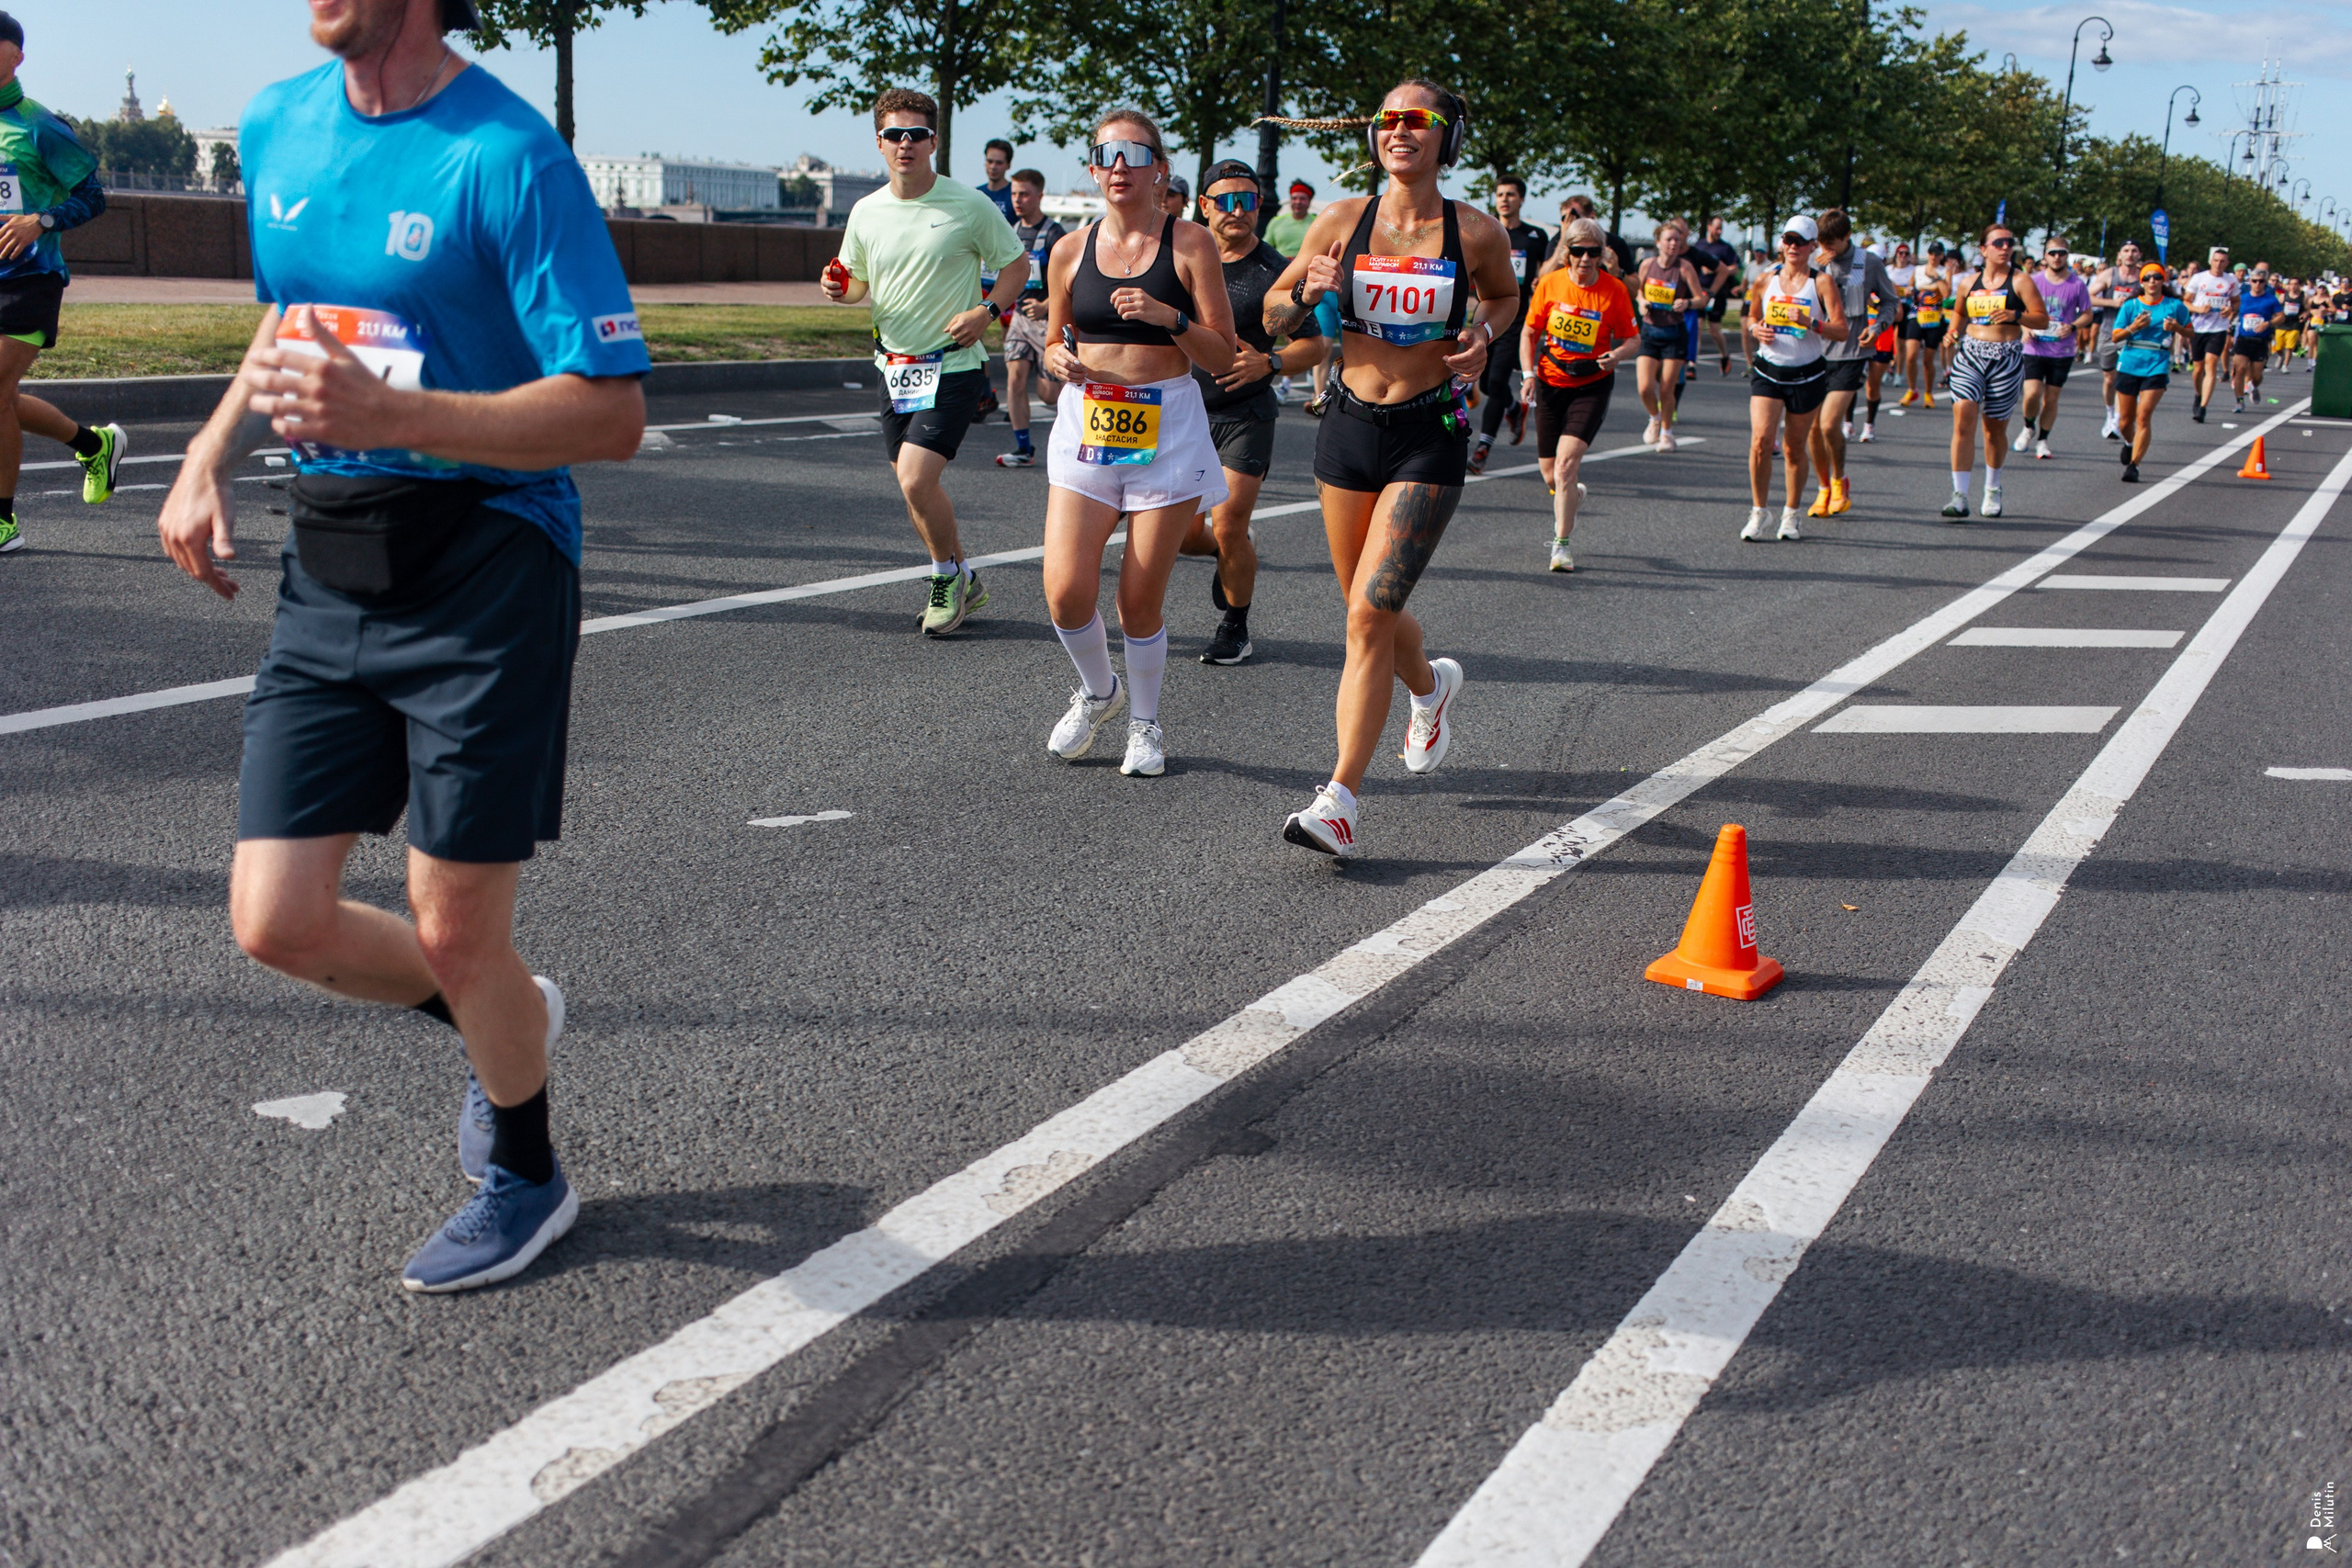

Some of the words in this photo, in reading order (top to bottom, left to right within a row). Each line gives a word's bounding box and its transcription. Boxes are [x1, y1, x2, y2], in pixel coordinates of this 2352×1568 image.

[384, 209, 435, 262] 10
[1413, 262, 1428, 270] 21,1
[1366, 284, 1435, 314] 7101
[357, 321, 379, 337] 21,1
[1555, 316, 1592, 337] 3653
[890, 367, 934, 389] 6635
[1125, 390, 1137, 399] 21,1
[1090, 407, 1148, 435] 6386
[1095, 434, 1138, 445] АНАСТАСИЯ
[1086, 447, 1094, 461] D
